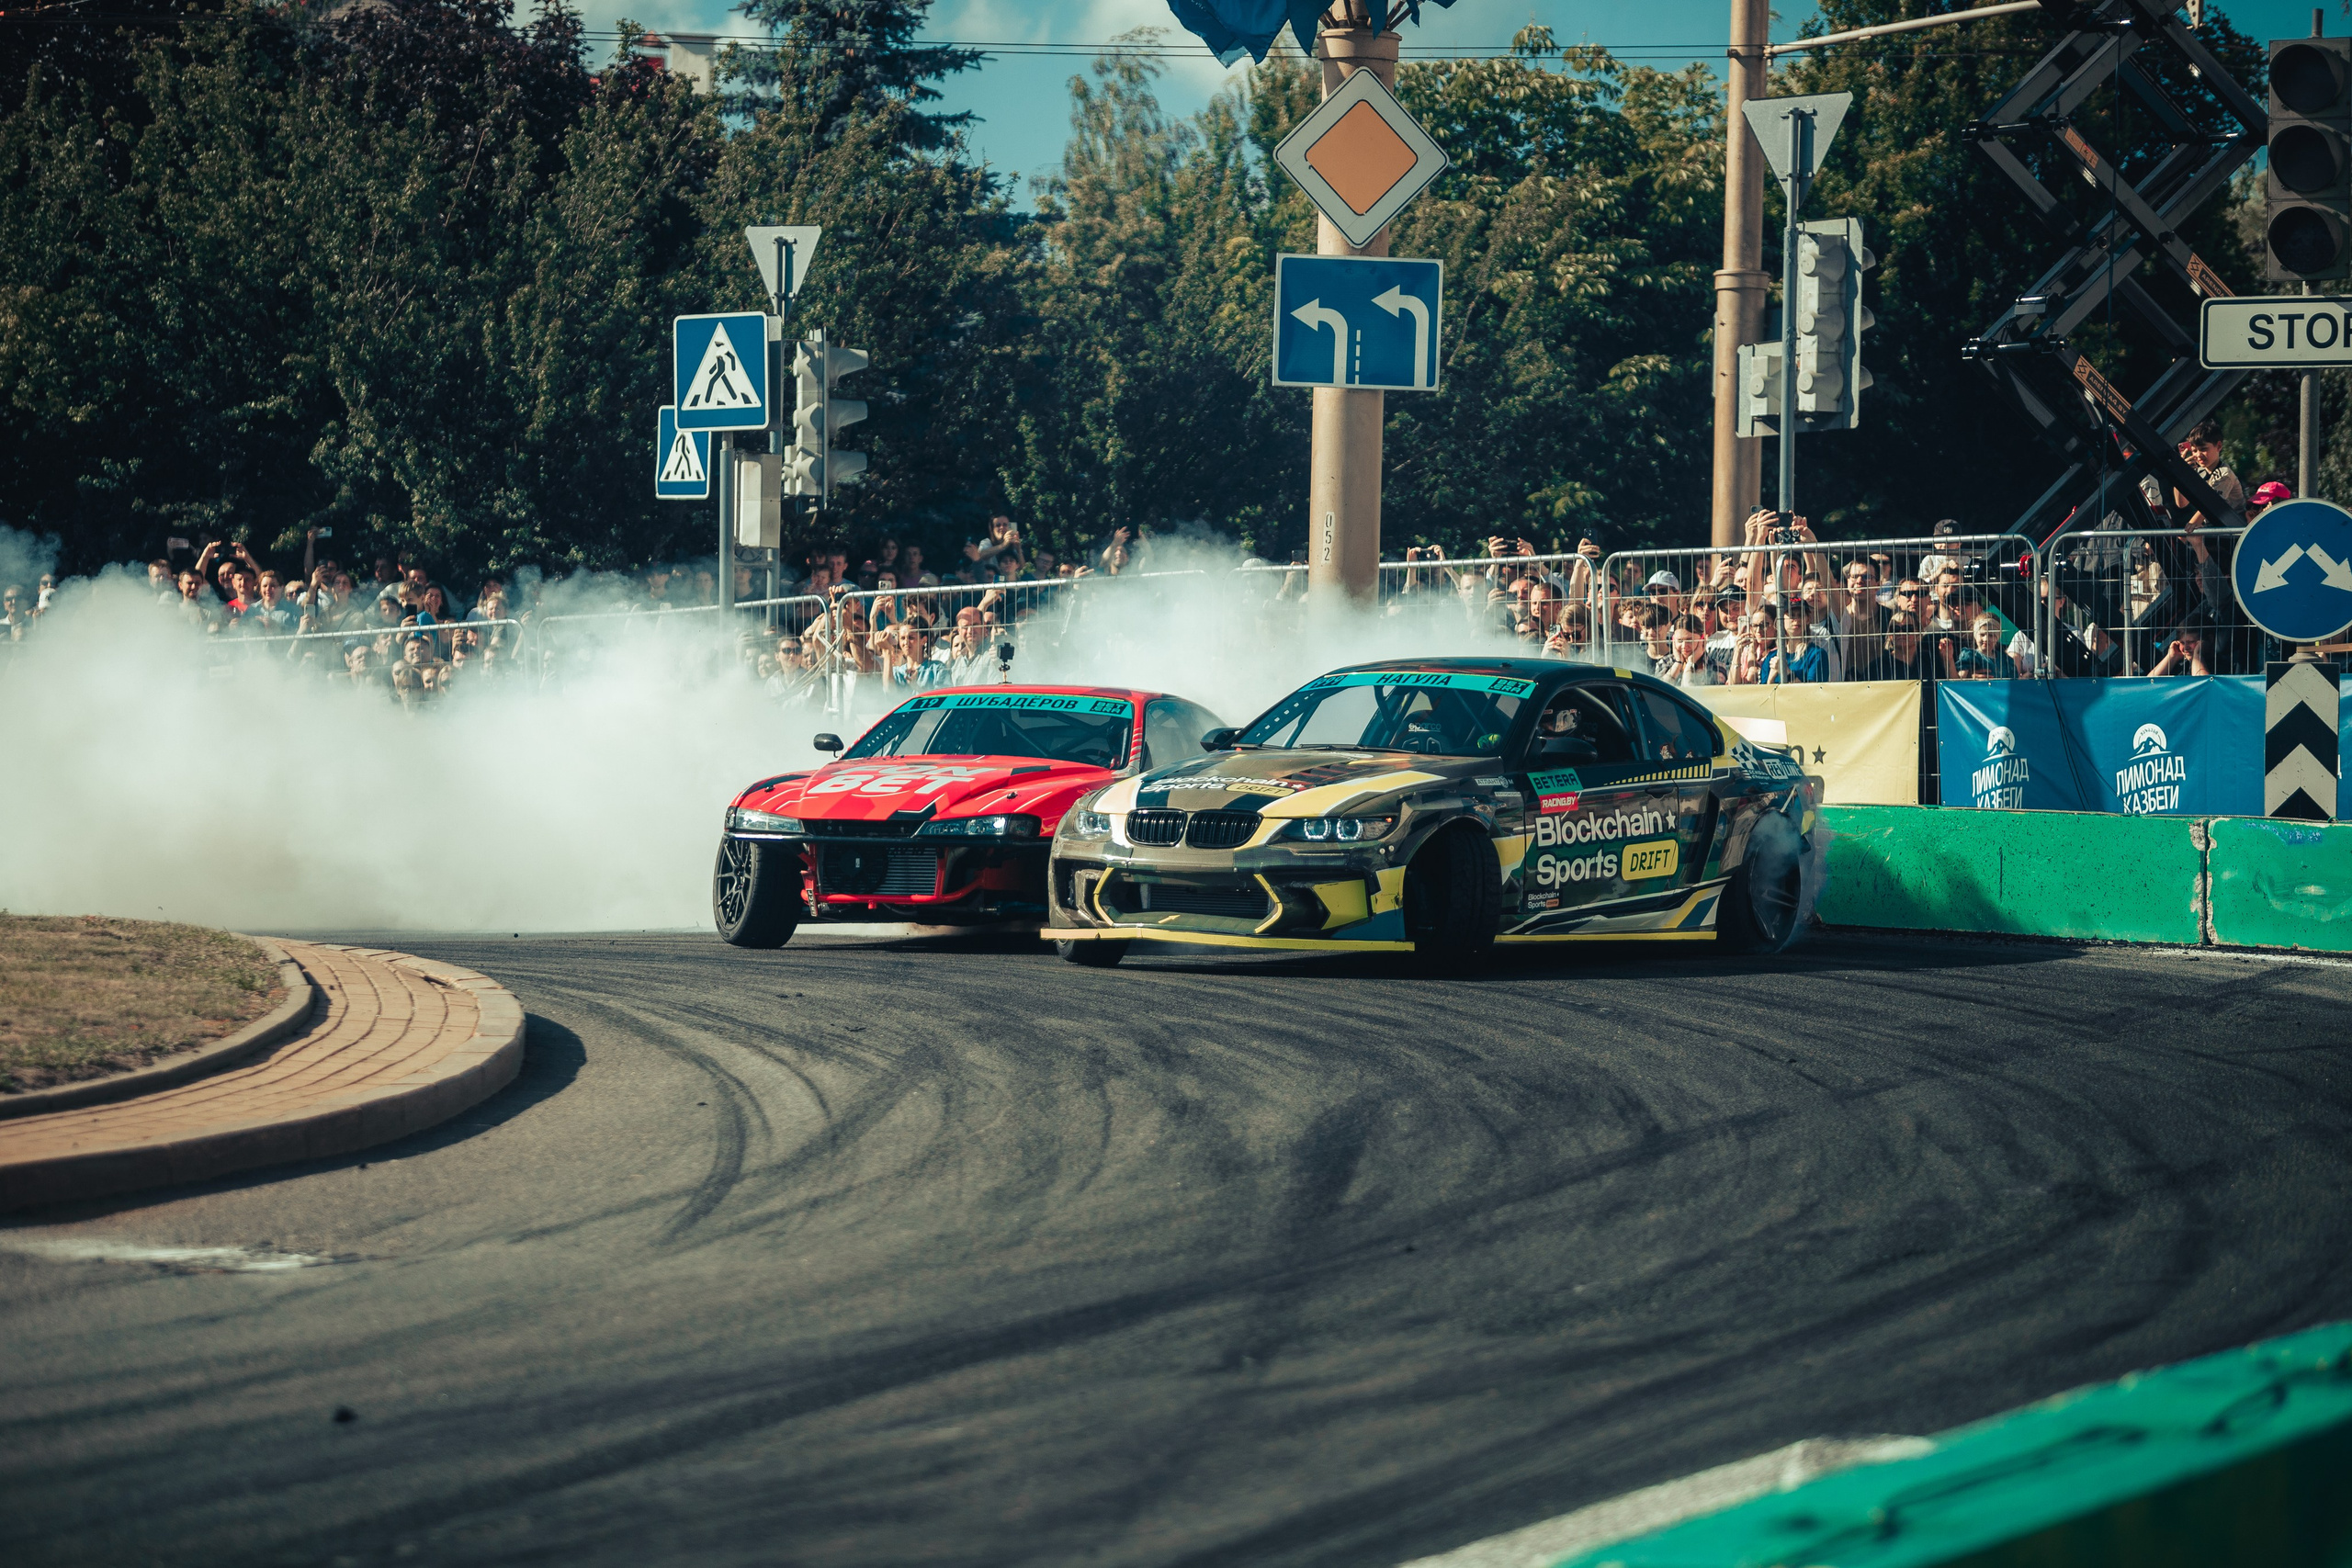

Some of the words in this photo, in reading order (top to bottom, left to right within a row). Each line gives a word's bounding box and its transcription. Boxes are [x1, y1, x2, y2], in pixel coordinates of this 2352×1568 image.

[1375, 673, 1453, 686] НАГУЛА
[921, 698, 938, 708] 19
[956, 696, 1079, 709] ШУБАДЁРОВ
[831, 765, 997, 776] FON
[2116, 756, 2186, 797] ЛИМОНАД
[807, 774, 976, 794] BET
[1973, 758, 2029, 797] ЛИМОНАД
[1236, 784, 1286, 795] DRIFT
[2124, 785, 2179, 814] КАЗБЕГИ
[1535, 806, 1663, 847] Blockchain
[1536, 848, 1618, 889] Sports
[1630, 849, 1670, 873] DRIFT
[1527, 892, 1556, 900] Blockchain
[1527, 901, 1545, 909] Sports
